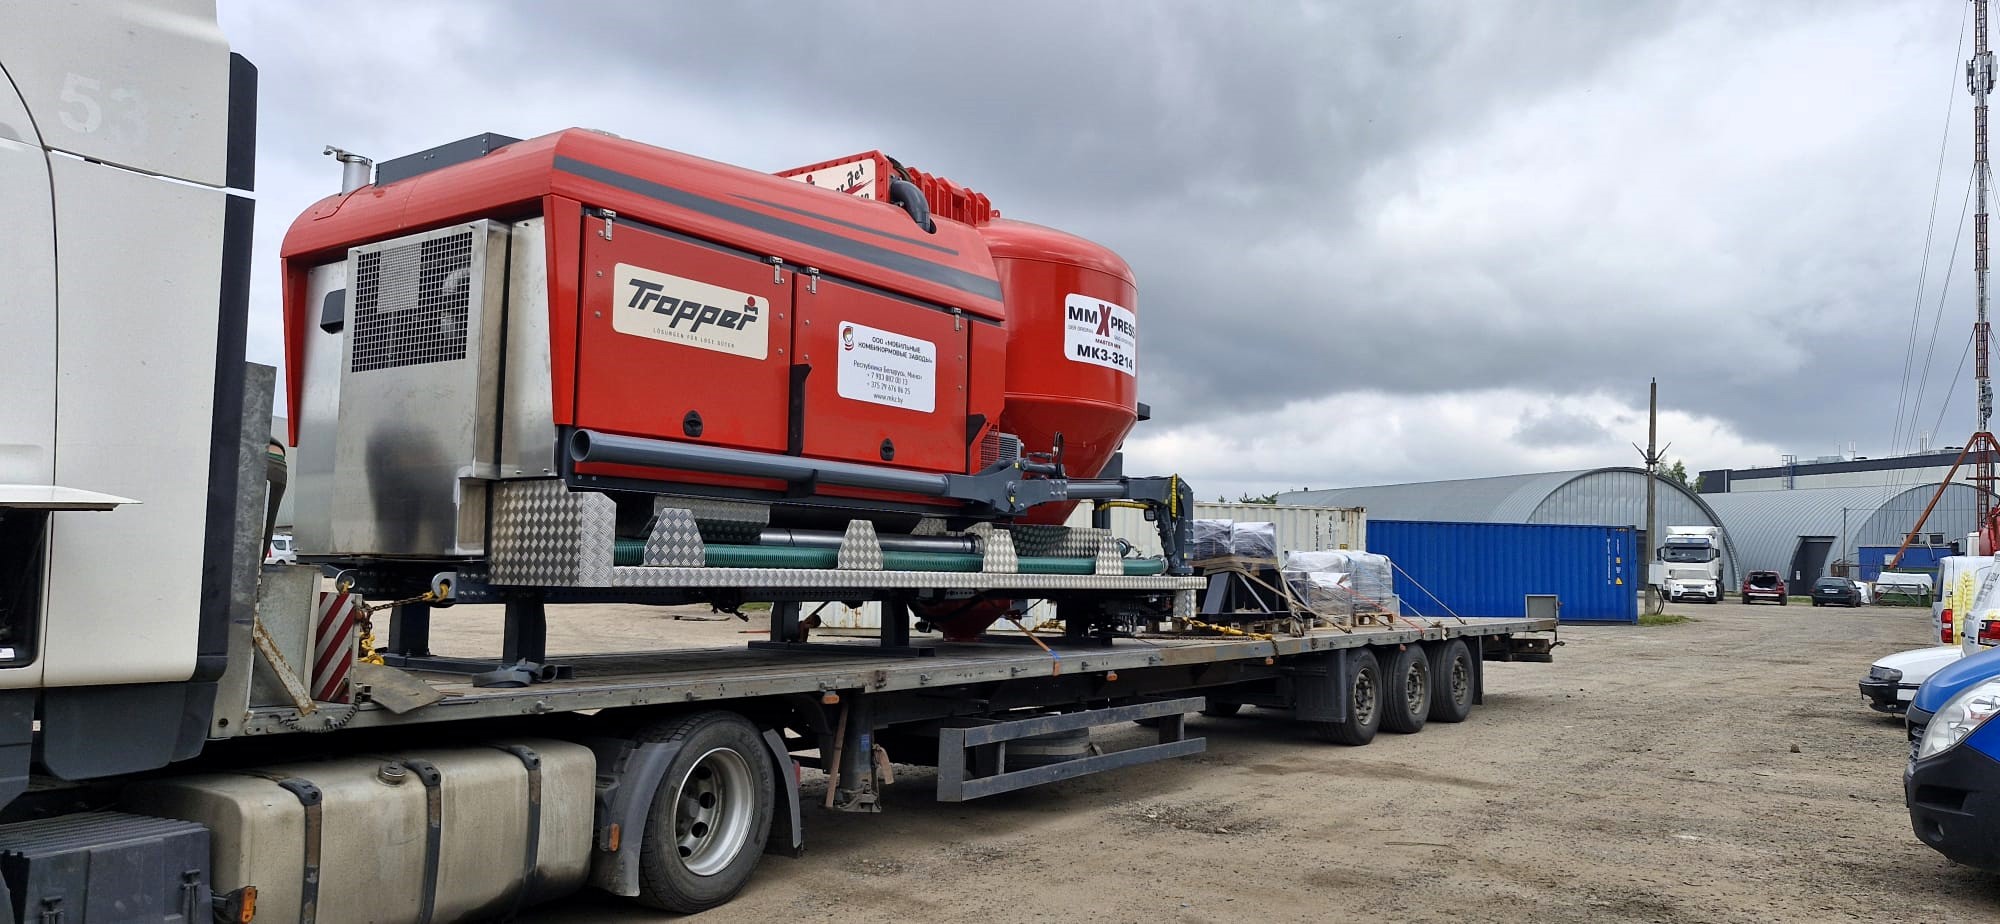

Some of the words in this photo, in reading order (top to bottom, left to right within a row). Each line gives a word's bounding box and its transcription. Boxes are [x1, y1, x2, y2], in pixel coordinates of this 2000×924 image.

[628, 278, 758, 333] Tropper
[1095, 338, 1114, 347] MASTER
[871, 381, 880, 389] 375
